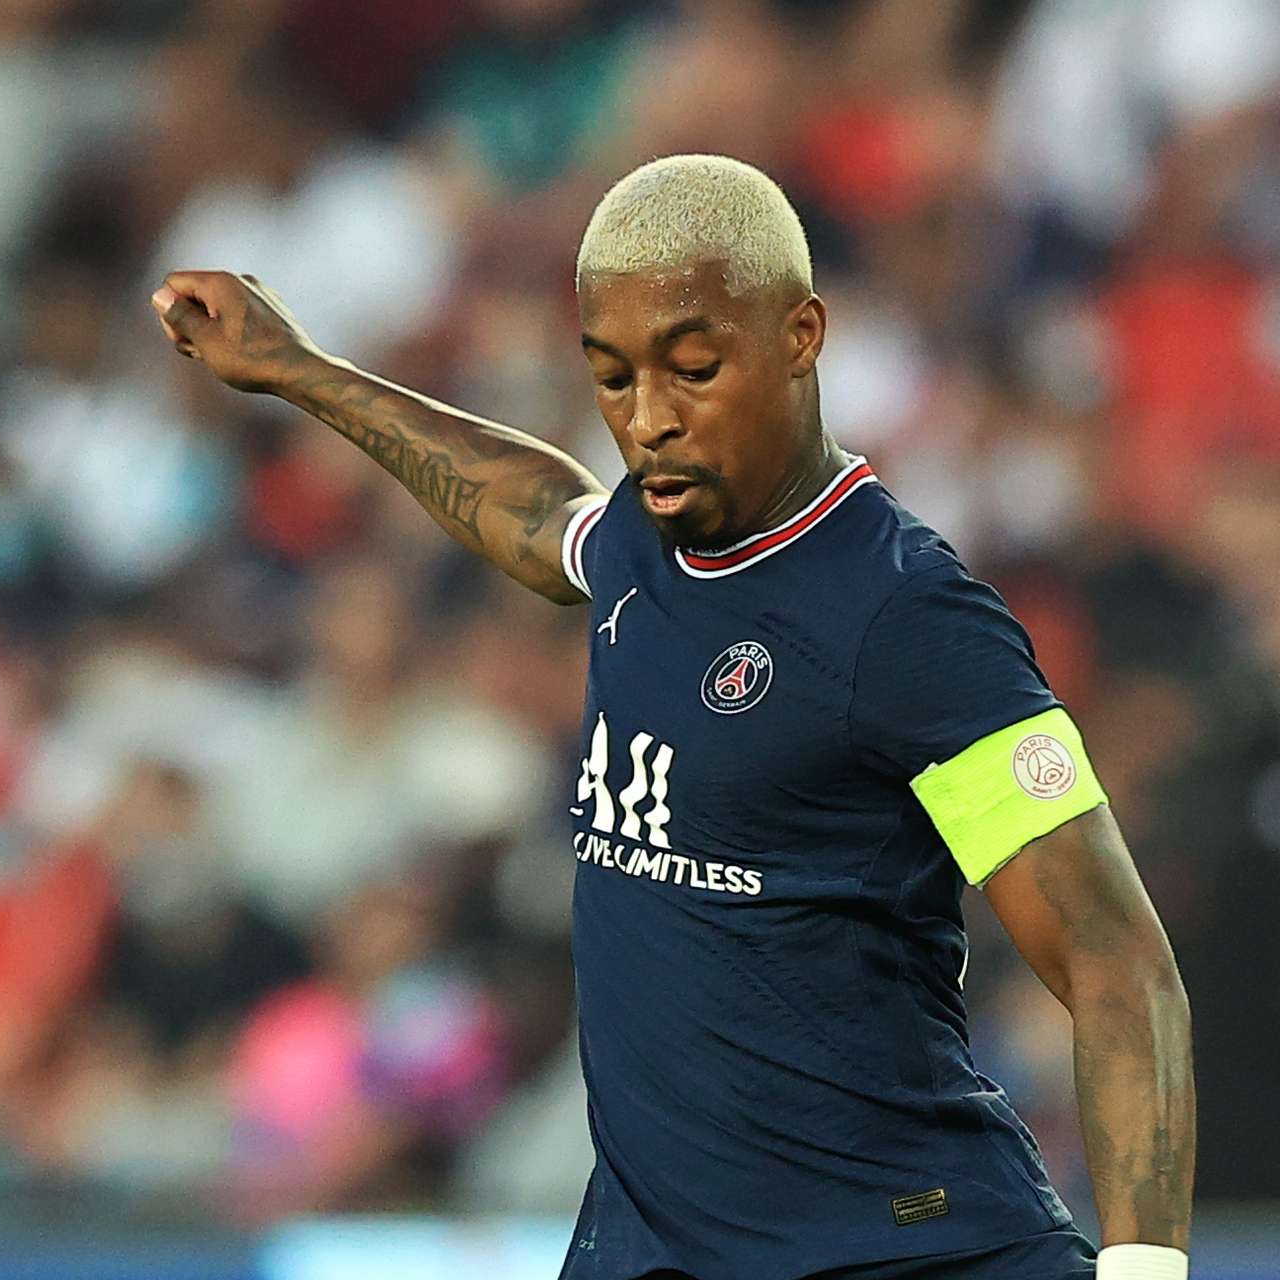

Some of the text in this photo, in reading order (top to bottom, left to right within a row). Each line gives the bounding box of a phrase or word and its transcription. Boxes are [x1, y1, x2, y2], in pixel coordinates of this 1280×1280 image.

[729, 646, 768, 670] PARIS
[1017, 738, 1052, 762] PARIS
[613, 843, 764, 897] LIMITLESS
